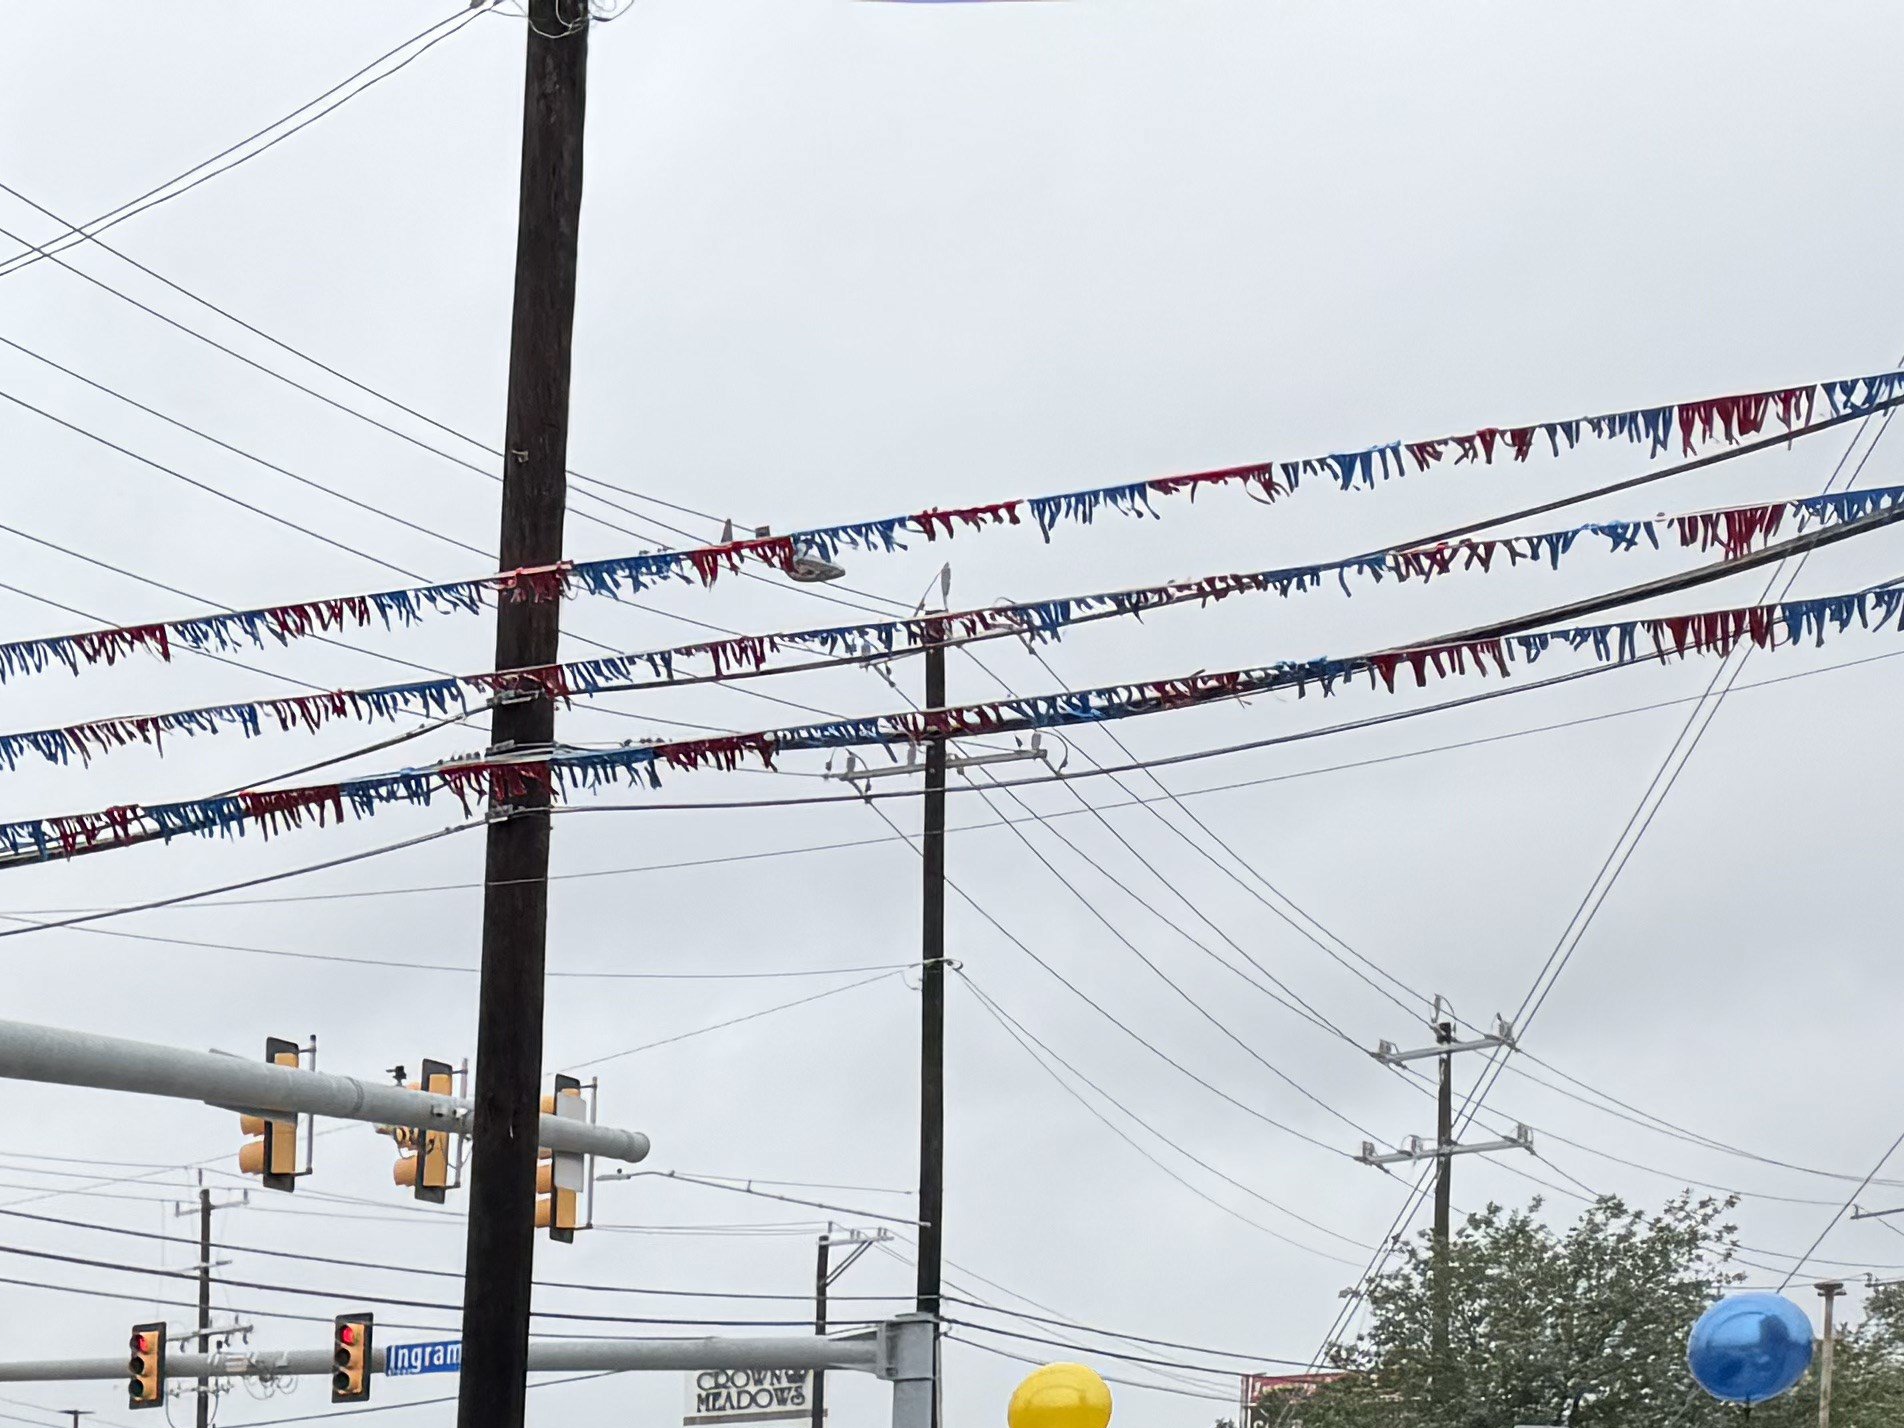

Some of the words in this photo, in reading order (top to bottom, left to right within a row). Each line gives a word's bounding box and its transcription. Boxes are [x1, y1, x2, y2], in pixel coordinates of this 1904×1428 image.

[390, 1344, 462, 1373] Ingram
[696, 1368, 784, 1392] CROWN
[696, 1386, 805, 1413] MEADOWS
